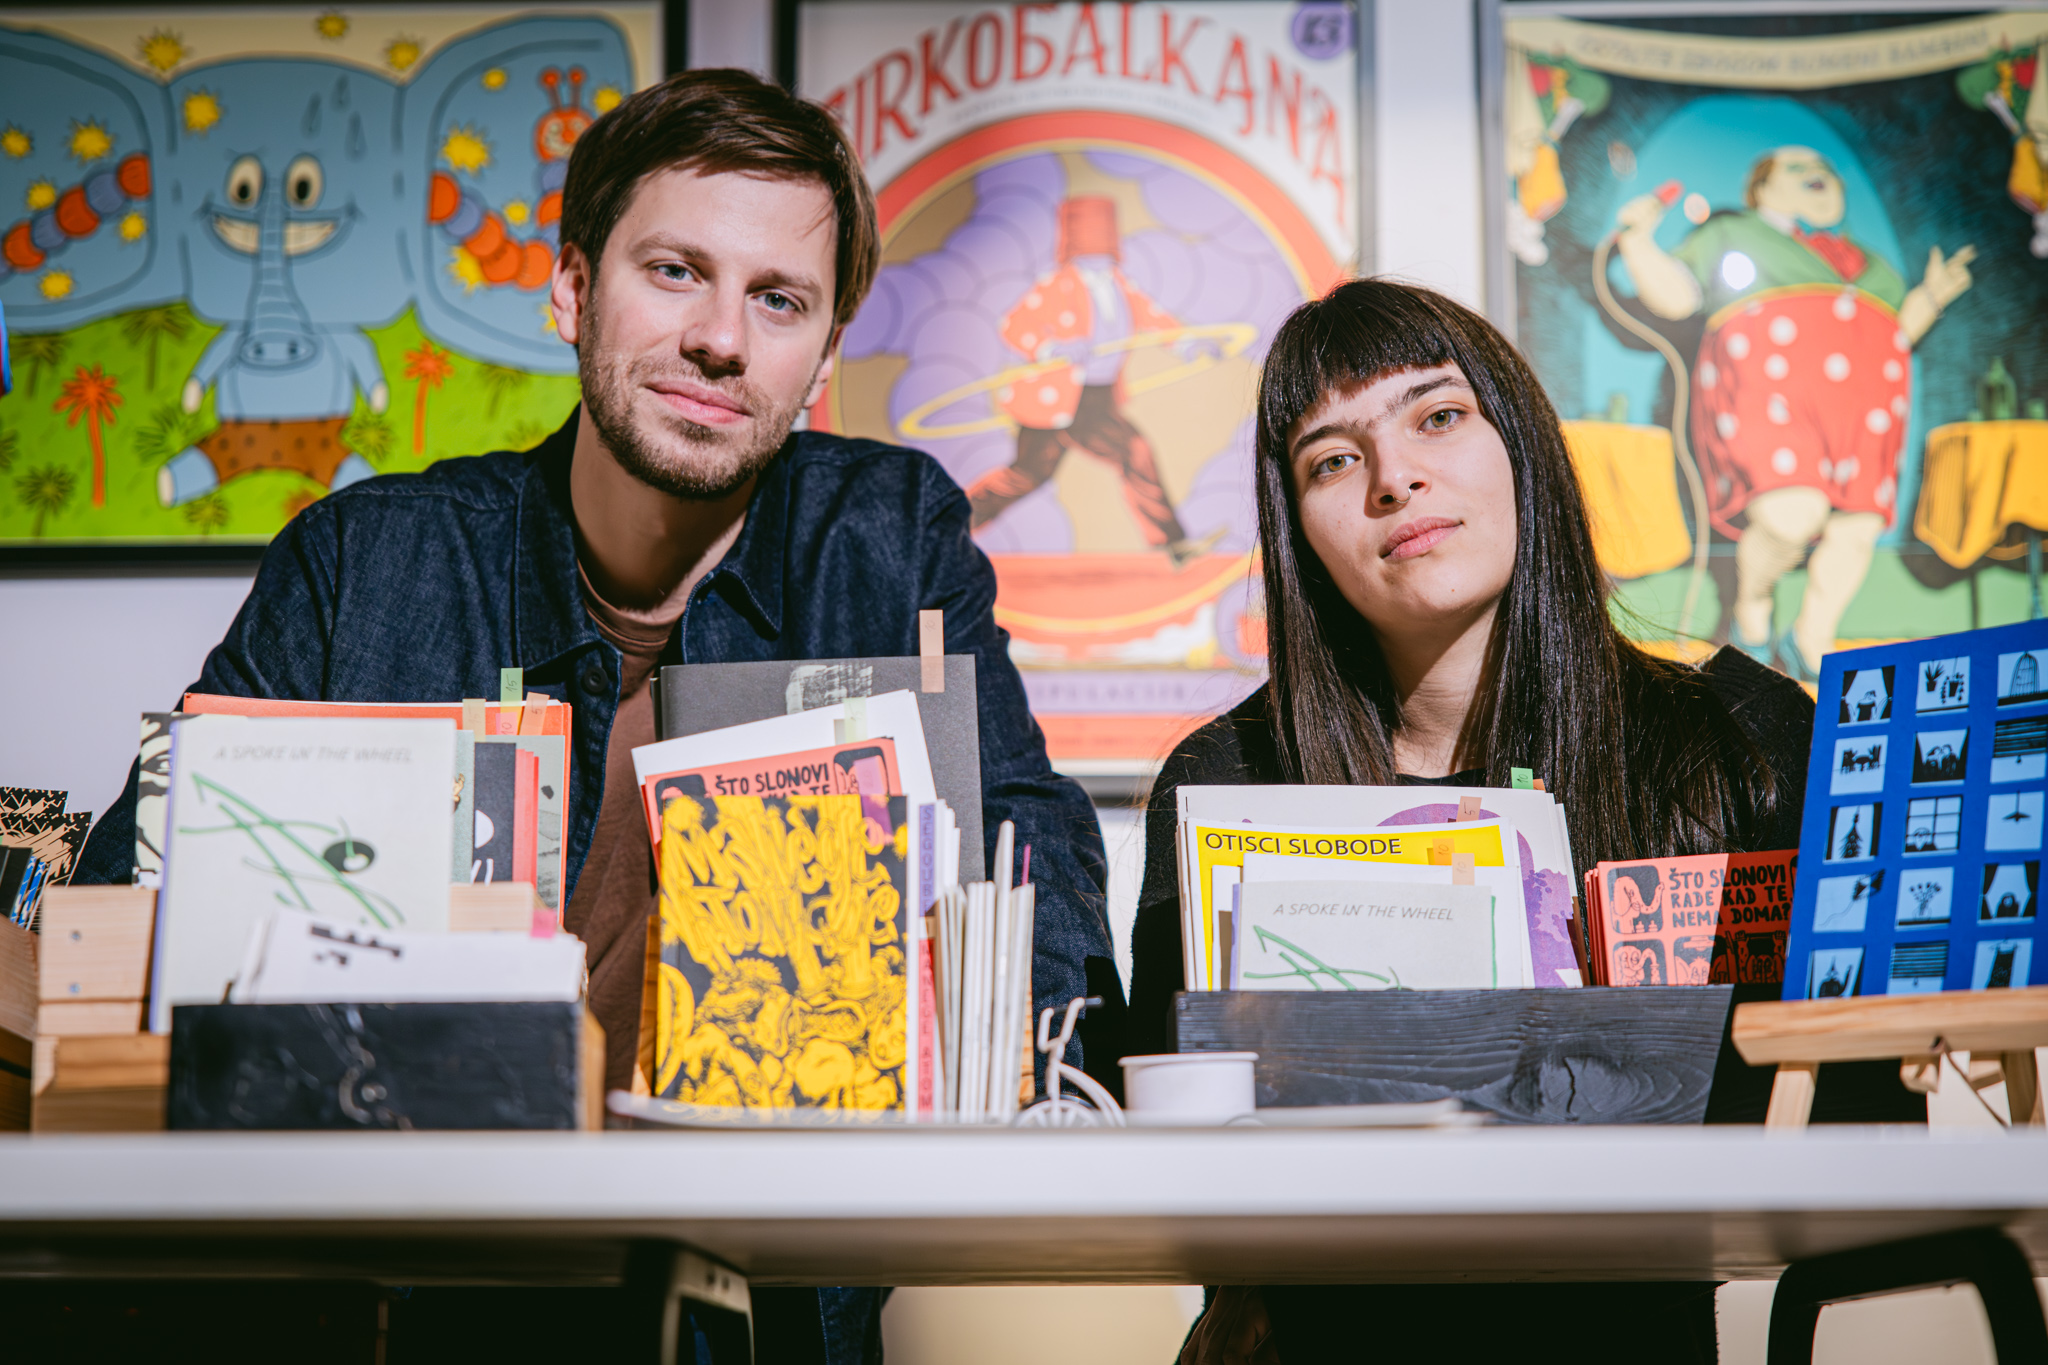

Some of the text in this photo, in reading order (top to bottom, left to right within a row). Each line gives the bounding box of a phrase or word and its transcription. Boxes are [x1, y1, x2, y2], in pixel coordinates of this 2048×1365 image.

[505, 673, 518, 692] 15
[230, 746, 287, 762] SPOKE
[316, 746, 351, 763] THE
[353, 747, 413, 765] WHEEL
[715, 762, 830, 796] ŠTO SLONOVI
[1205, 832, 1402, 856] OTISCI SLOBODE
[1668, 864, 1786, 891] ŠTO SLONOVI
[1670, 884, 1788, 909] RADE KAD TE
[1273, 903, 1455, 922] A SPOKE IN THE WHEEL
[1672, 902, 1792, 928] NEMA DOMA?
